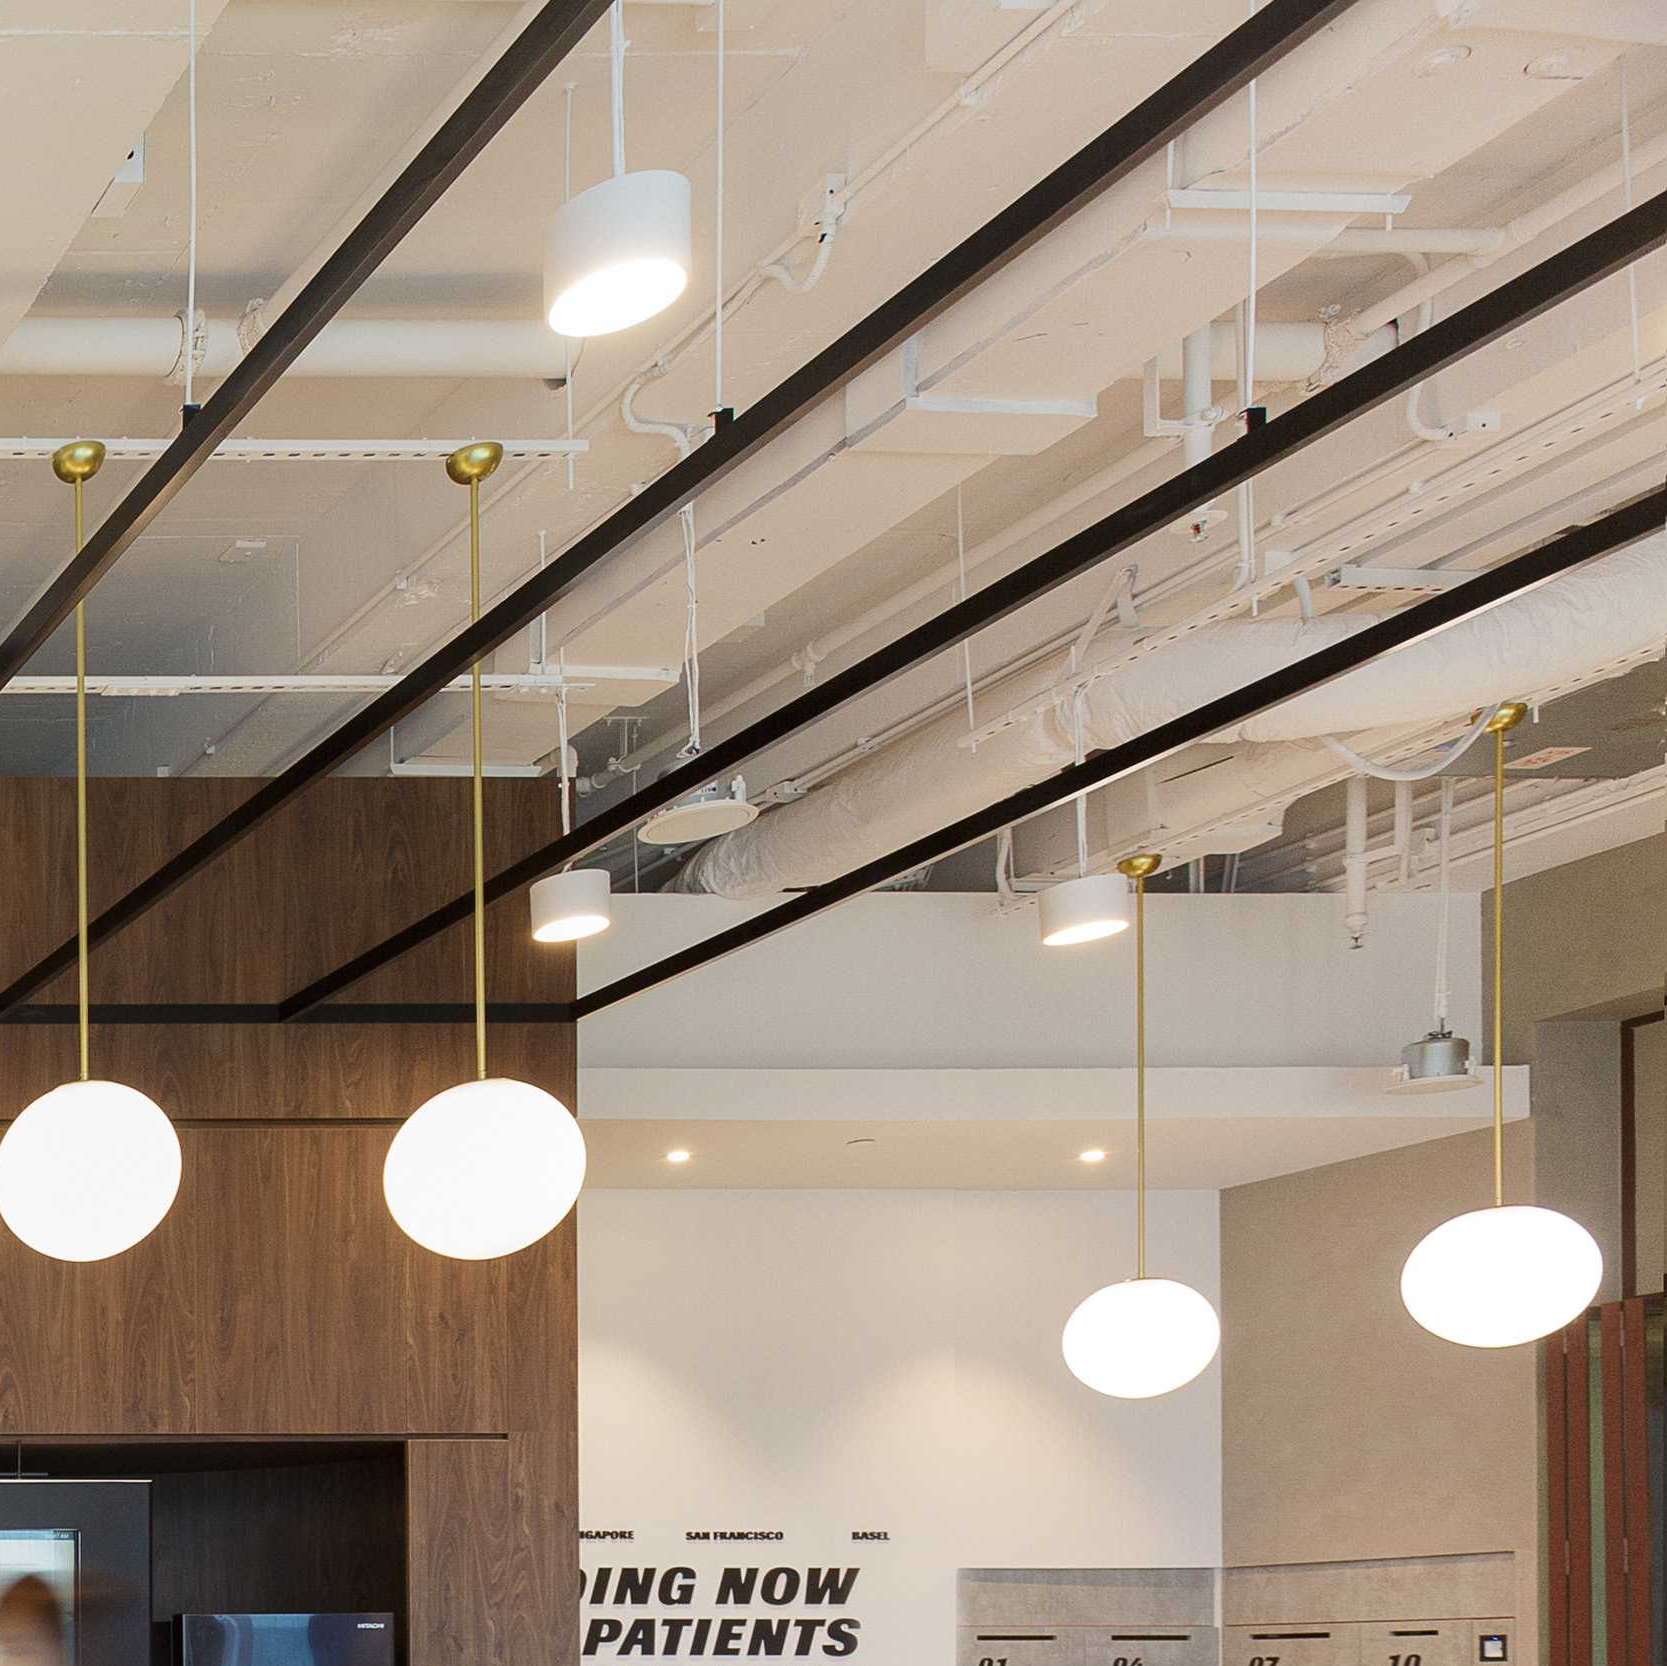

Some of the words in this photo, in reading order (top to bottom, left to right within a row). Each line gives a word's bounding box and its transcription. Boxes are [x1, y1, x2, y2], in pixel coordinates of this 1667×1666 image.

[685, 1531, 710, 1540] SAN
[713, 1531, 784, 1541] FRANCISCO
[851, 1531, 891, 1541] BASEL
[715, 1566, 861, 1606] NOW
[582, 1617, 862, 1657] PATIENTS
